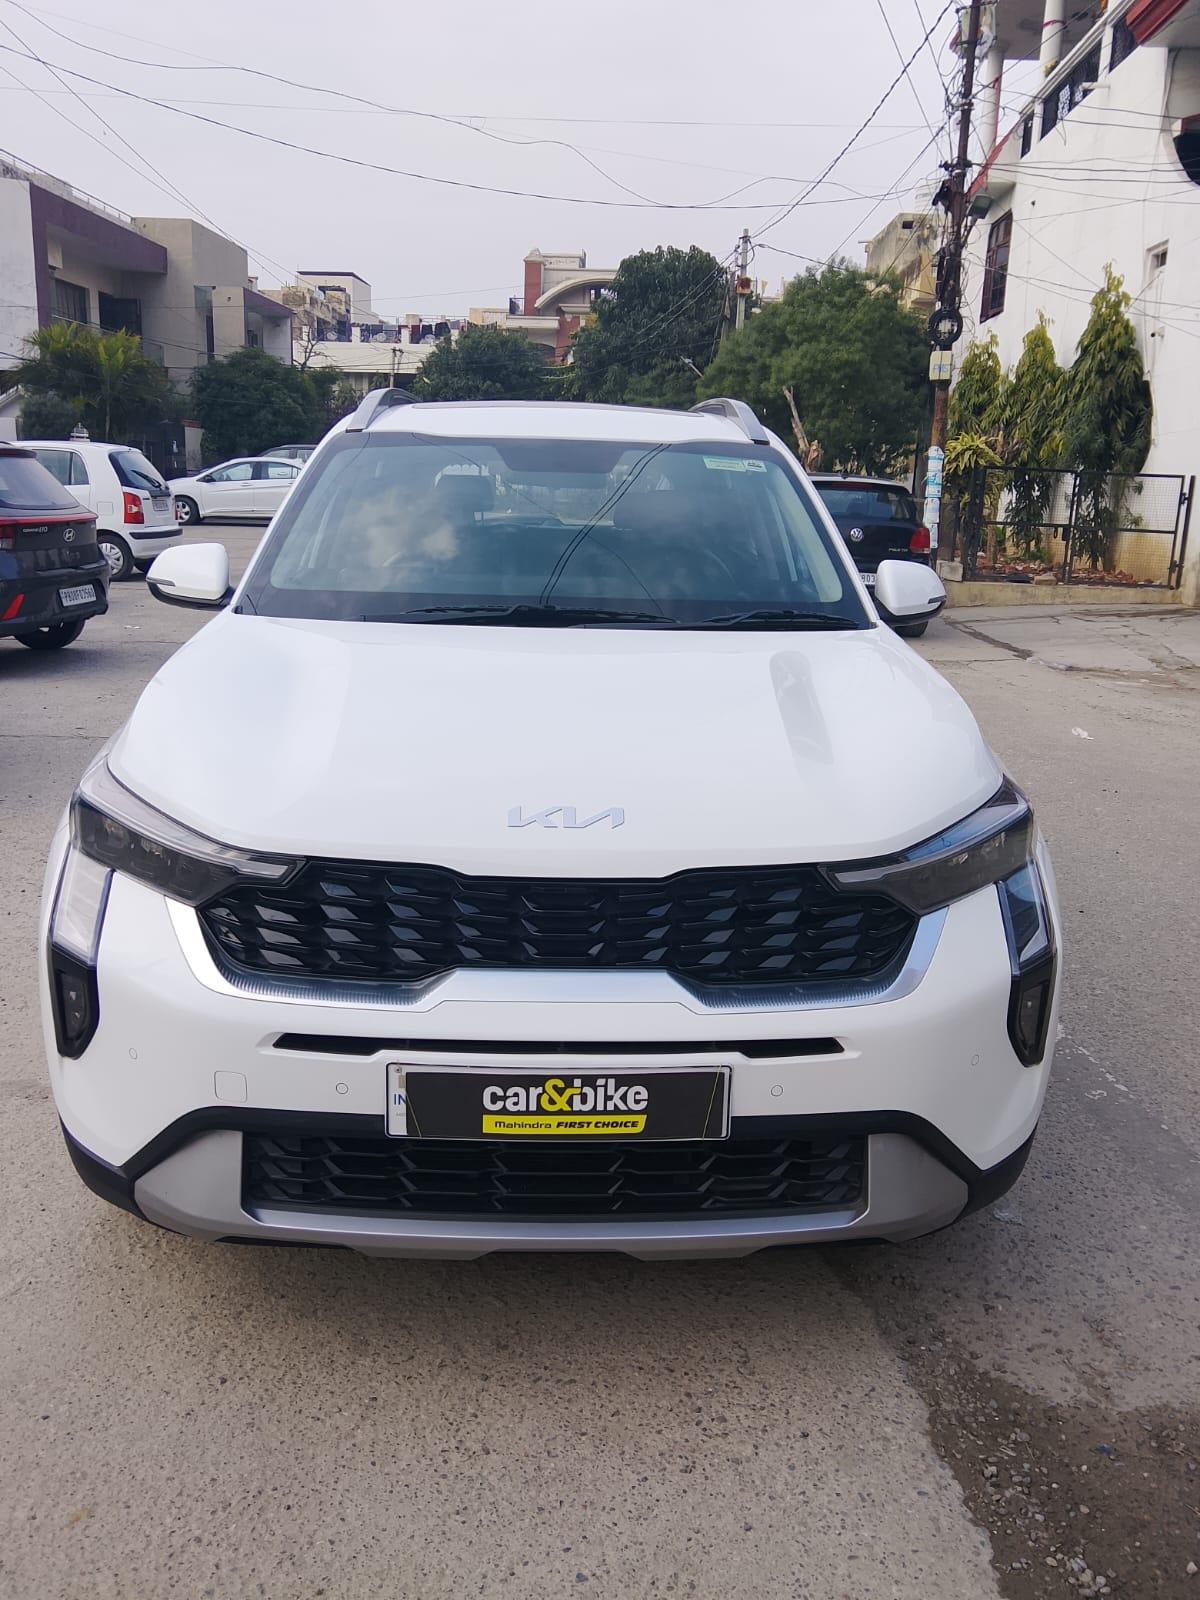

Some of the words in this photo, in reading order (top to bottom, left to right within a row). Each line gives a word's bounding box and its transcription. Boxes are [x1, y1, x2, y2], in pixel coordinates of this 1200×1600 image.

[482, 1078, 649, 1112] car&bike
[494, 1121, 552, 1129] Mahindra
[556, 1121, 592, 1129] FIRST
[594, 1120, 640, 1129] CHOICE
